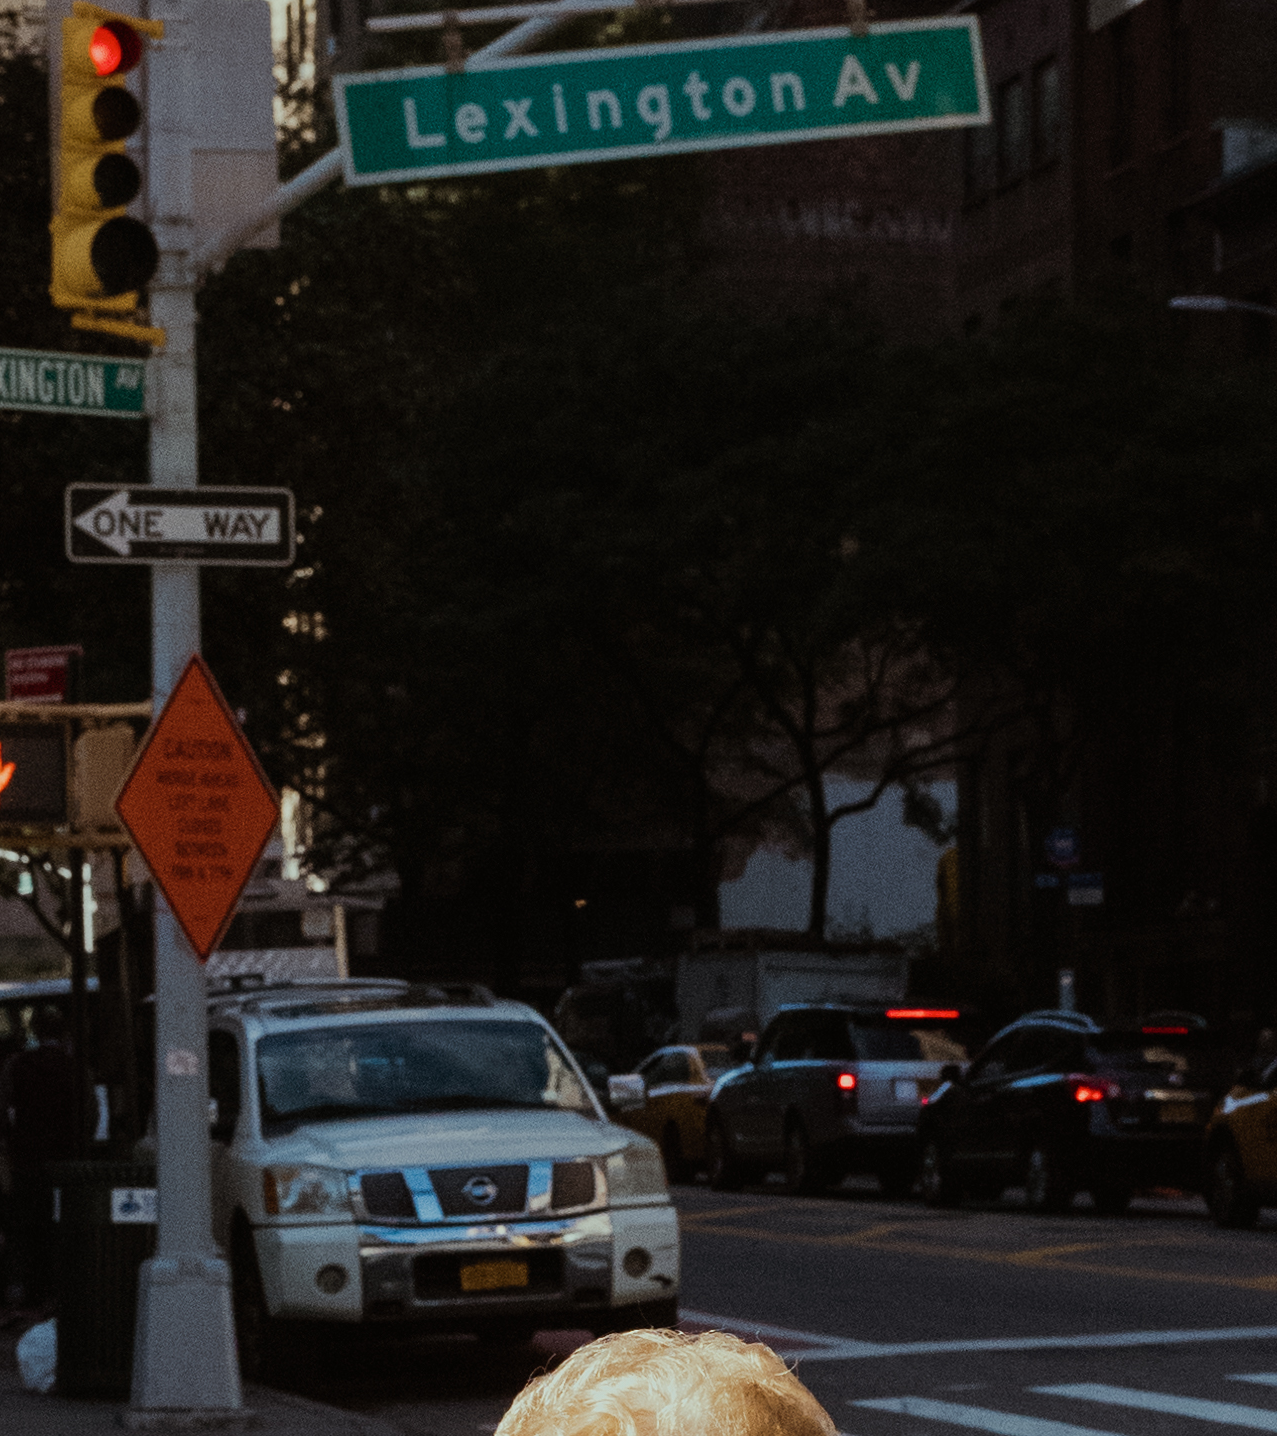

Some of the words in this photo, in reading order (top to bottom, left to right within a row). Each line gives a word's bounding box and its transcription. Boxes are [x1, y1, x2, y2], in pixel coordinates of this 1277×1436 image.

[403, 70, 807, 149] Lexington
[833, 54, 922, 108] Av
[93, 509, 164, 539] ONE
[204, 511, 271, 539] WAY
